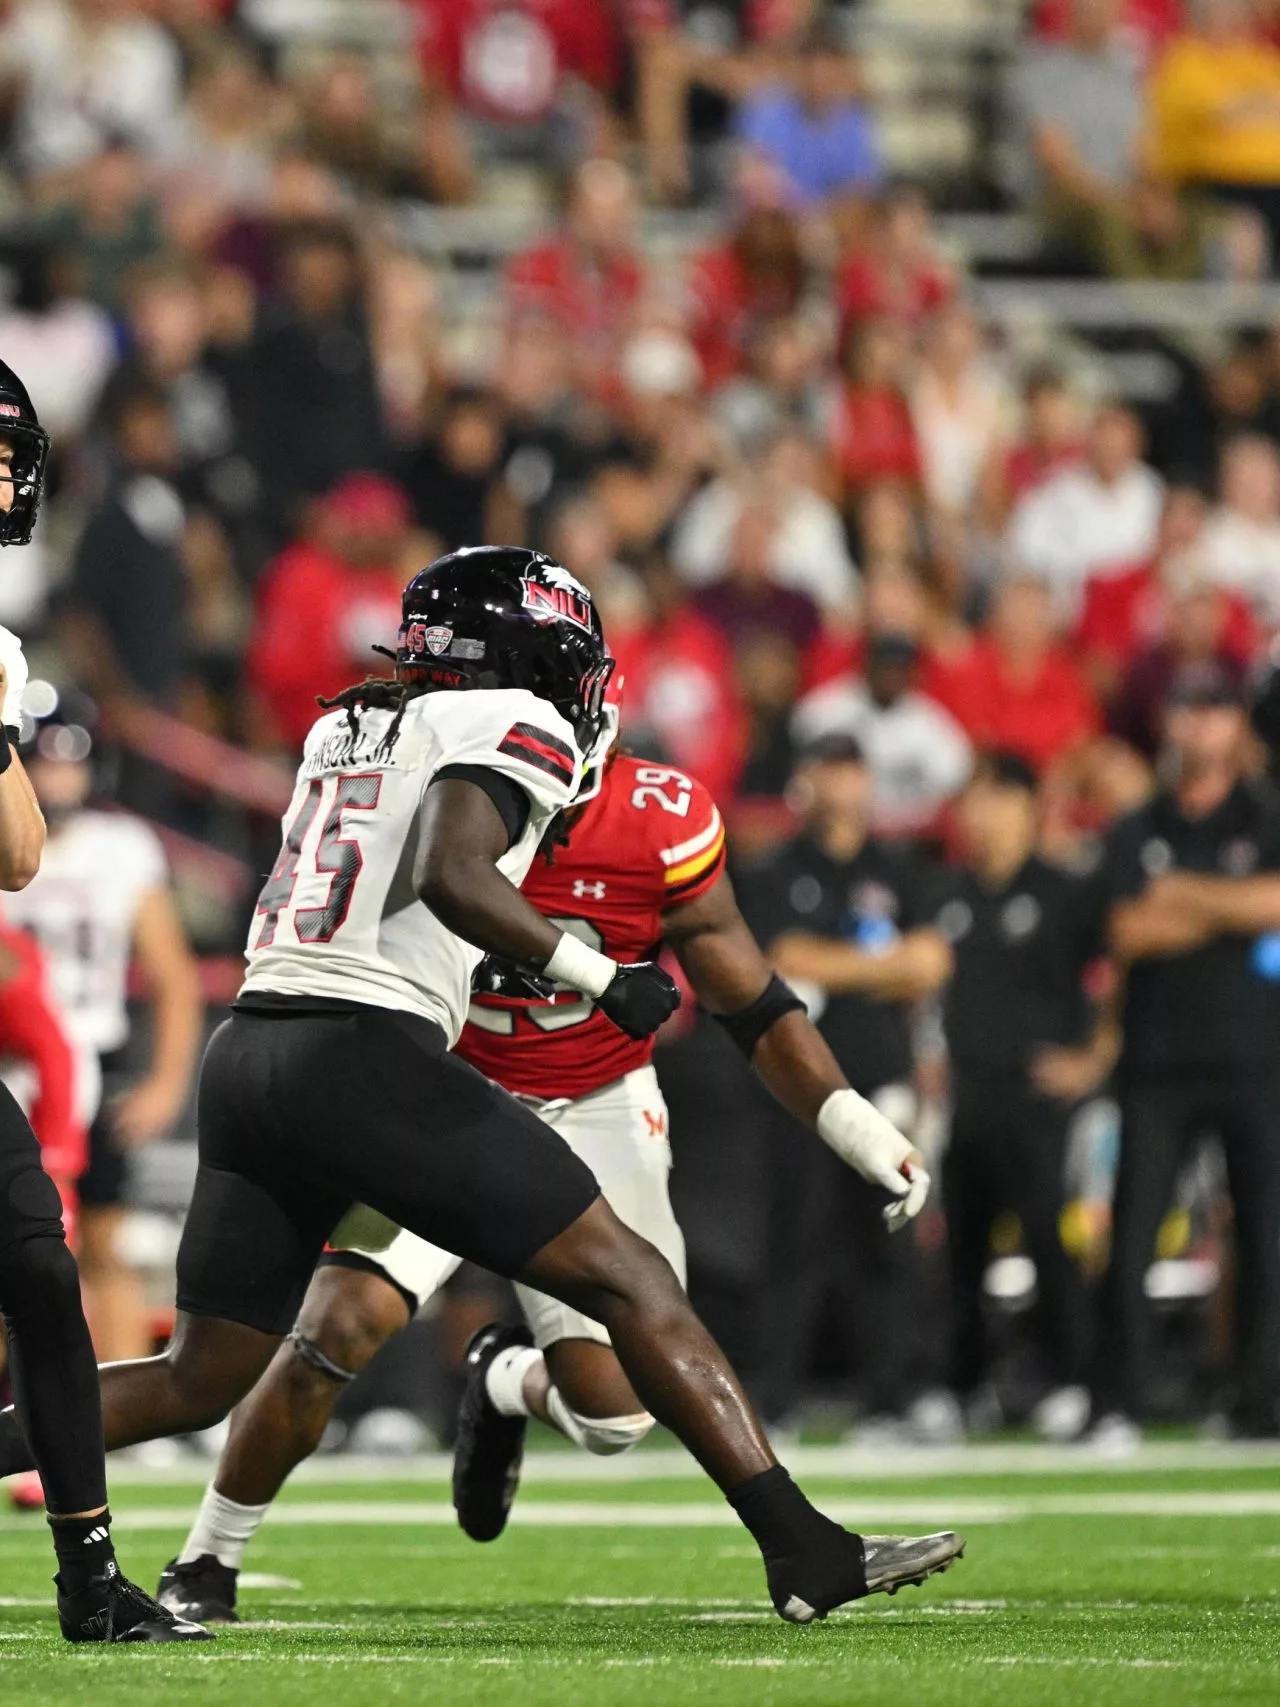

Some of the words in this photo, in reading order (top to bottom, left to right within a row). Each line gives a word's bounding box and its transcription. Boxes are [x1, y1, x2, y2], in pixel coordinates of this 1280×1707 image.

[524, 580, 589, 626] NIU
[406, 623, 426, 653] 45
[631, 767, 693, 817] 29
[255, 773, 383, 951] 45
